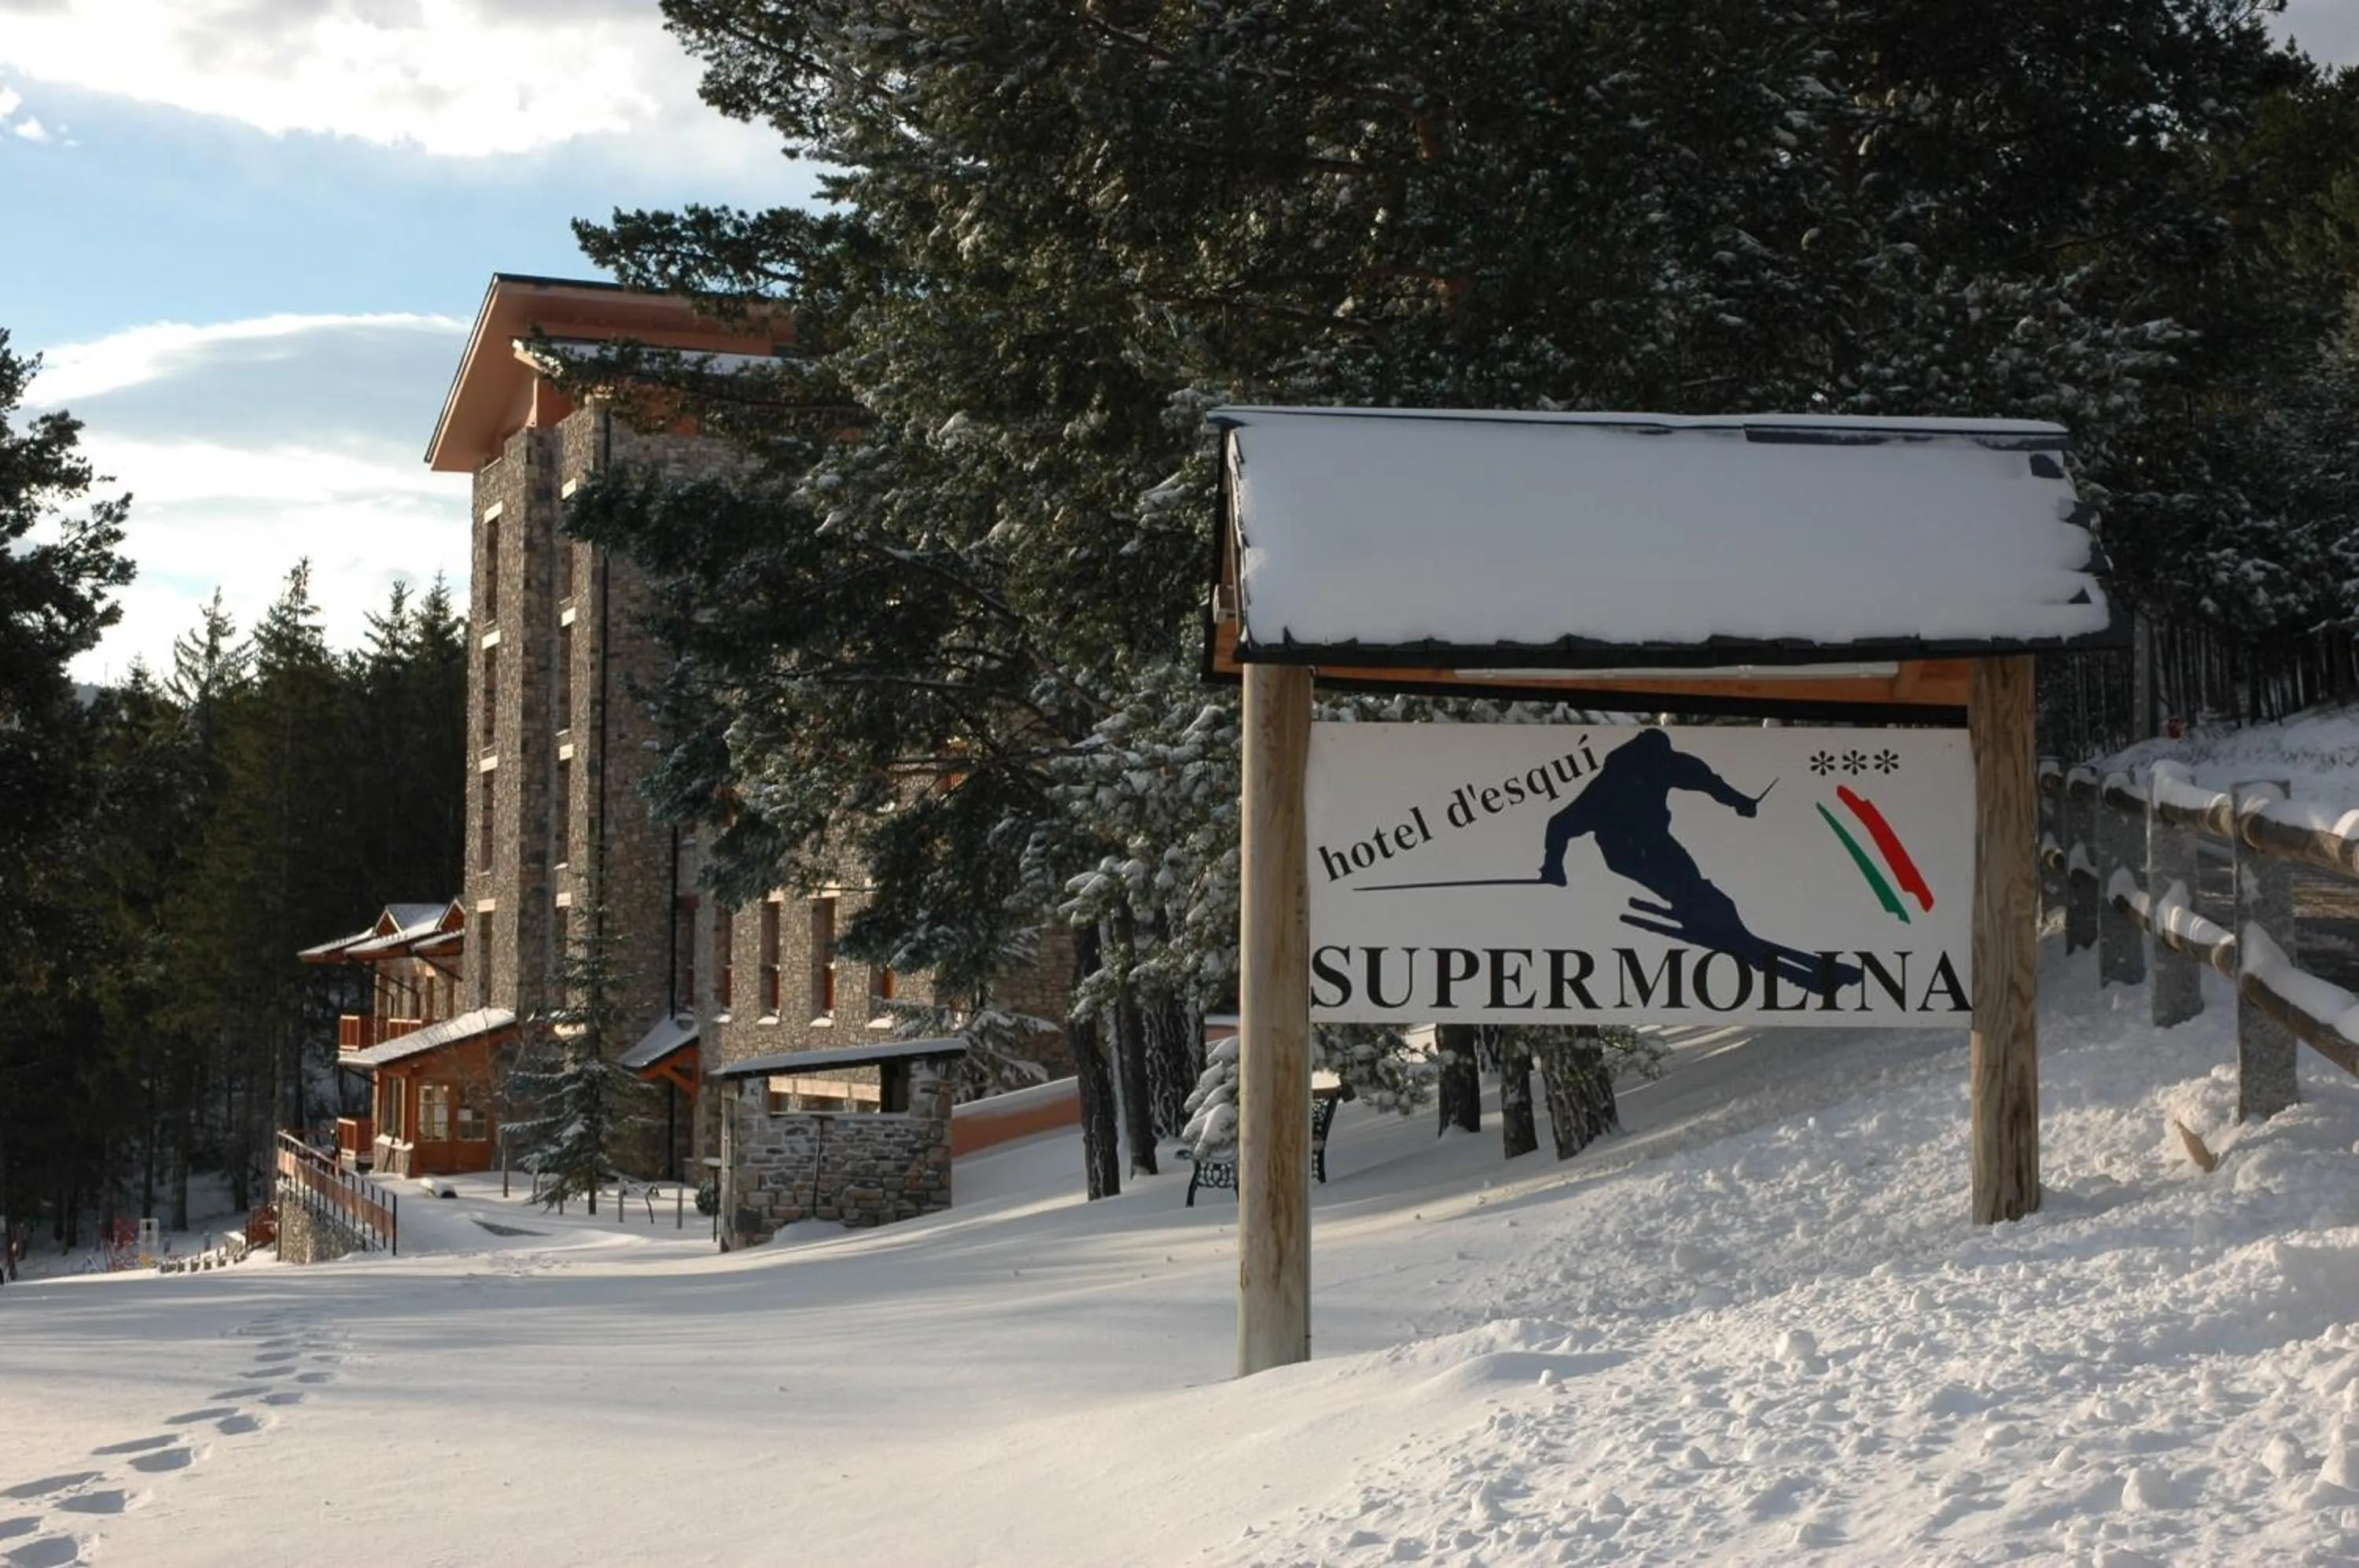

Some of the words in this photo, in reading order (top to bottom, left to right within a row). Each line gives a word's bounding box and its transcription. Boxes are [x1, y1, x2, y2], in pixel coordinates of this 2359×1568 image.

[1317, 805, 1433, 882] hotel
[1446, 734, 1603, 829] d'esquí
[1310, 944, 1974, 1012] SUPERMOLINA
